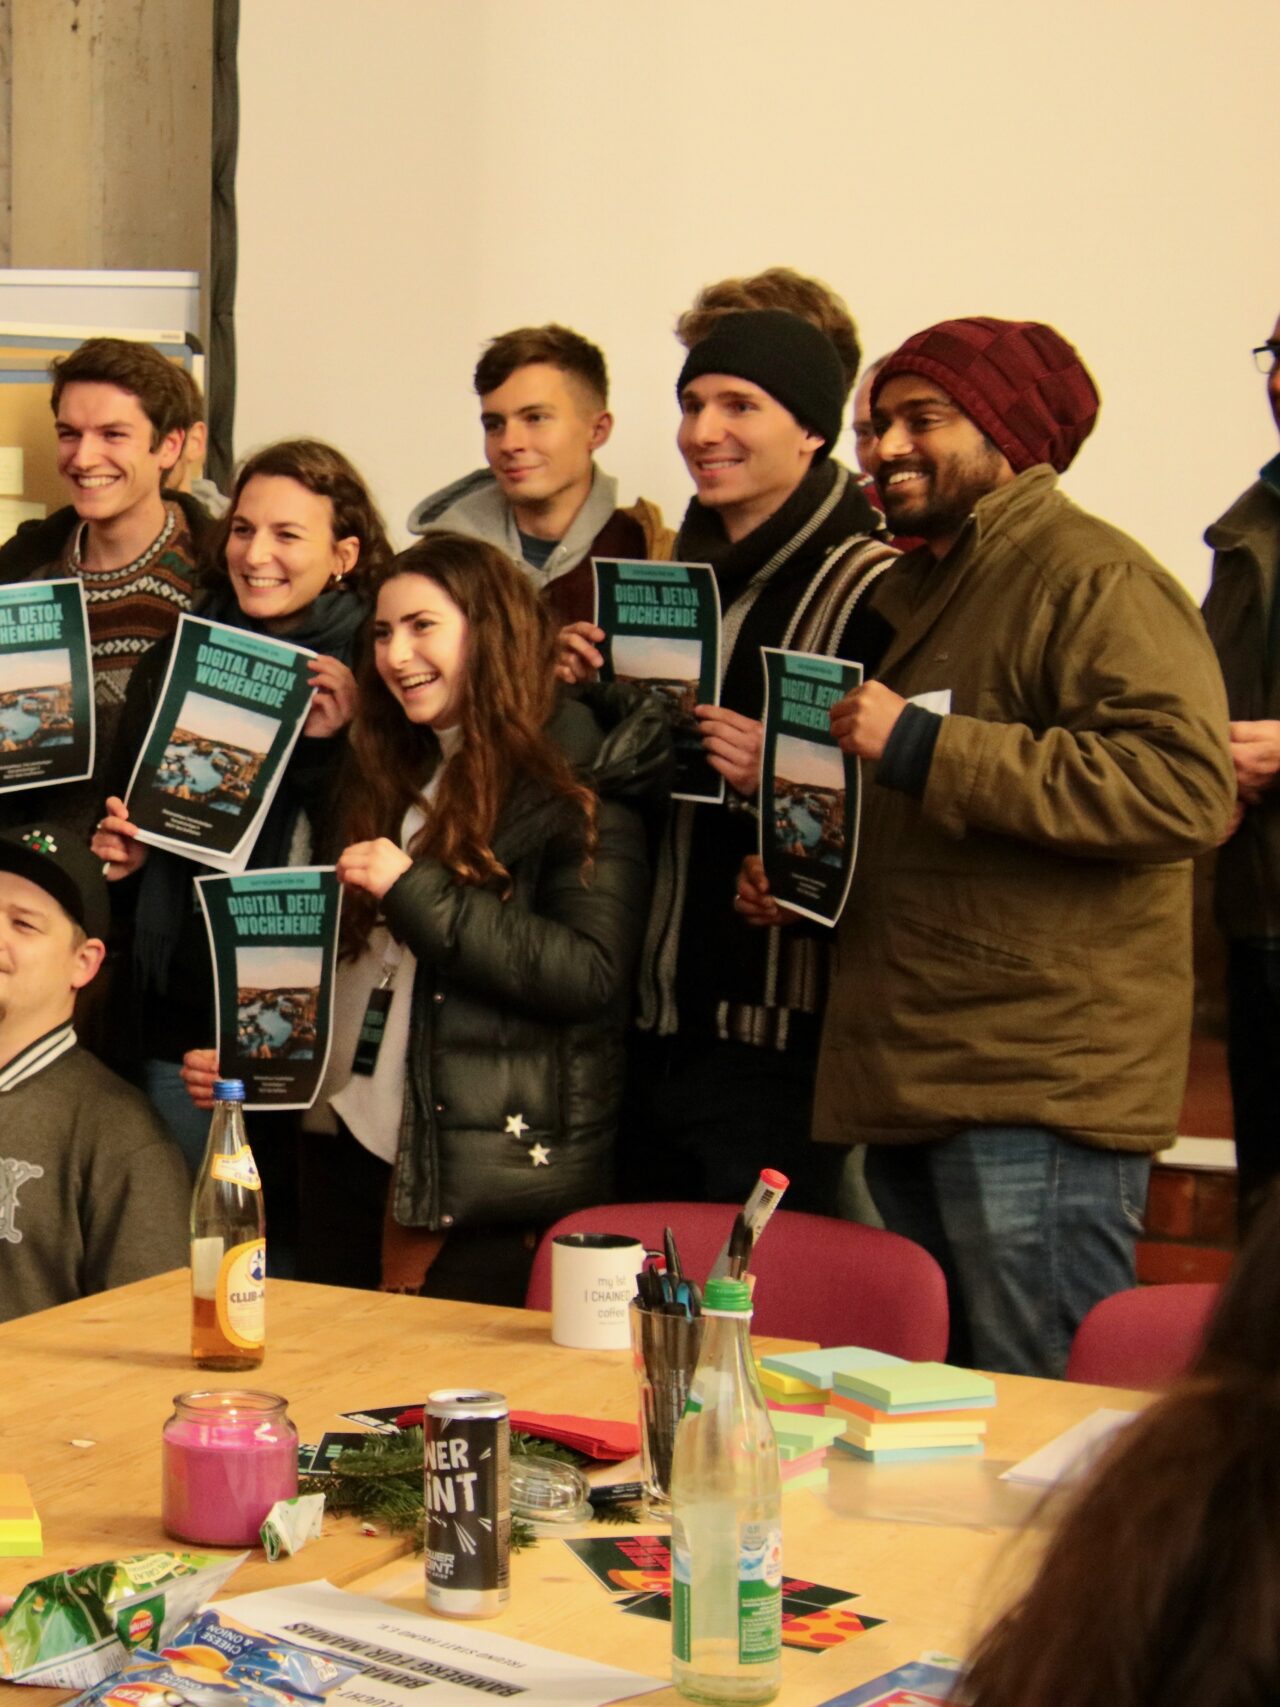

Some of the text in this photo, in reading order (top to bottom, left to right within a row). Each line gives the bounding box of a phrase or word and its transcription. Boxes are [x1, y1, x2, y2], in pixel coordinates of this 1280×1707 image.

[615, 585, 699, 607] DIGITAL DETOX
[19, 602, 64, 624] DETOX
[618, 605, 698, 628] WOCHENENDE
[197, 643, 248, 677] DIGITAL
[251, 661, 297, 692] DETOX
[195, 663, 287, 709] WOCHENENDE
[227, 894, 326, 916] DIGITAL DETOX
[234, 915, 322, 936] WOCHENENDE
[200, 1631, 242, 1655] CHEESE
[206, 1623, 244, 1645] ONION
[282, 1622, 370, 1653] MAMAS
[410, 1661, 527, 1698] BAMBERG
